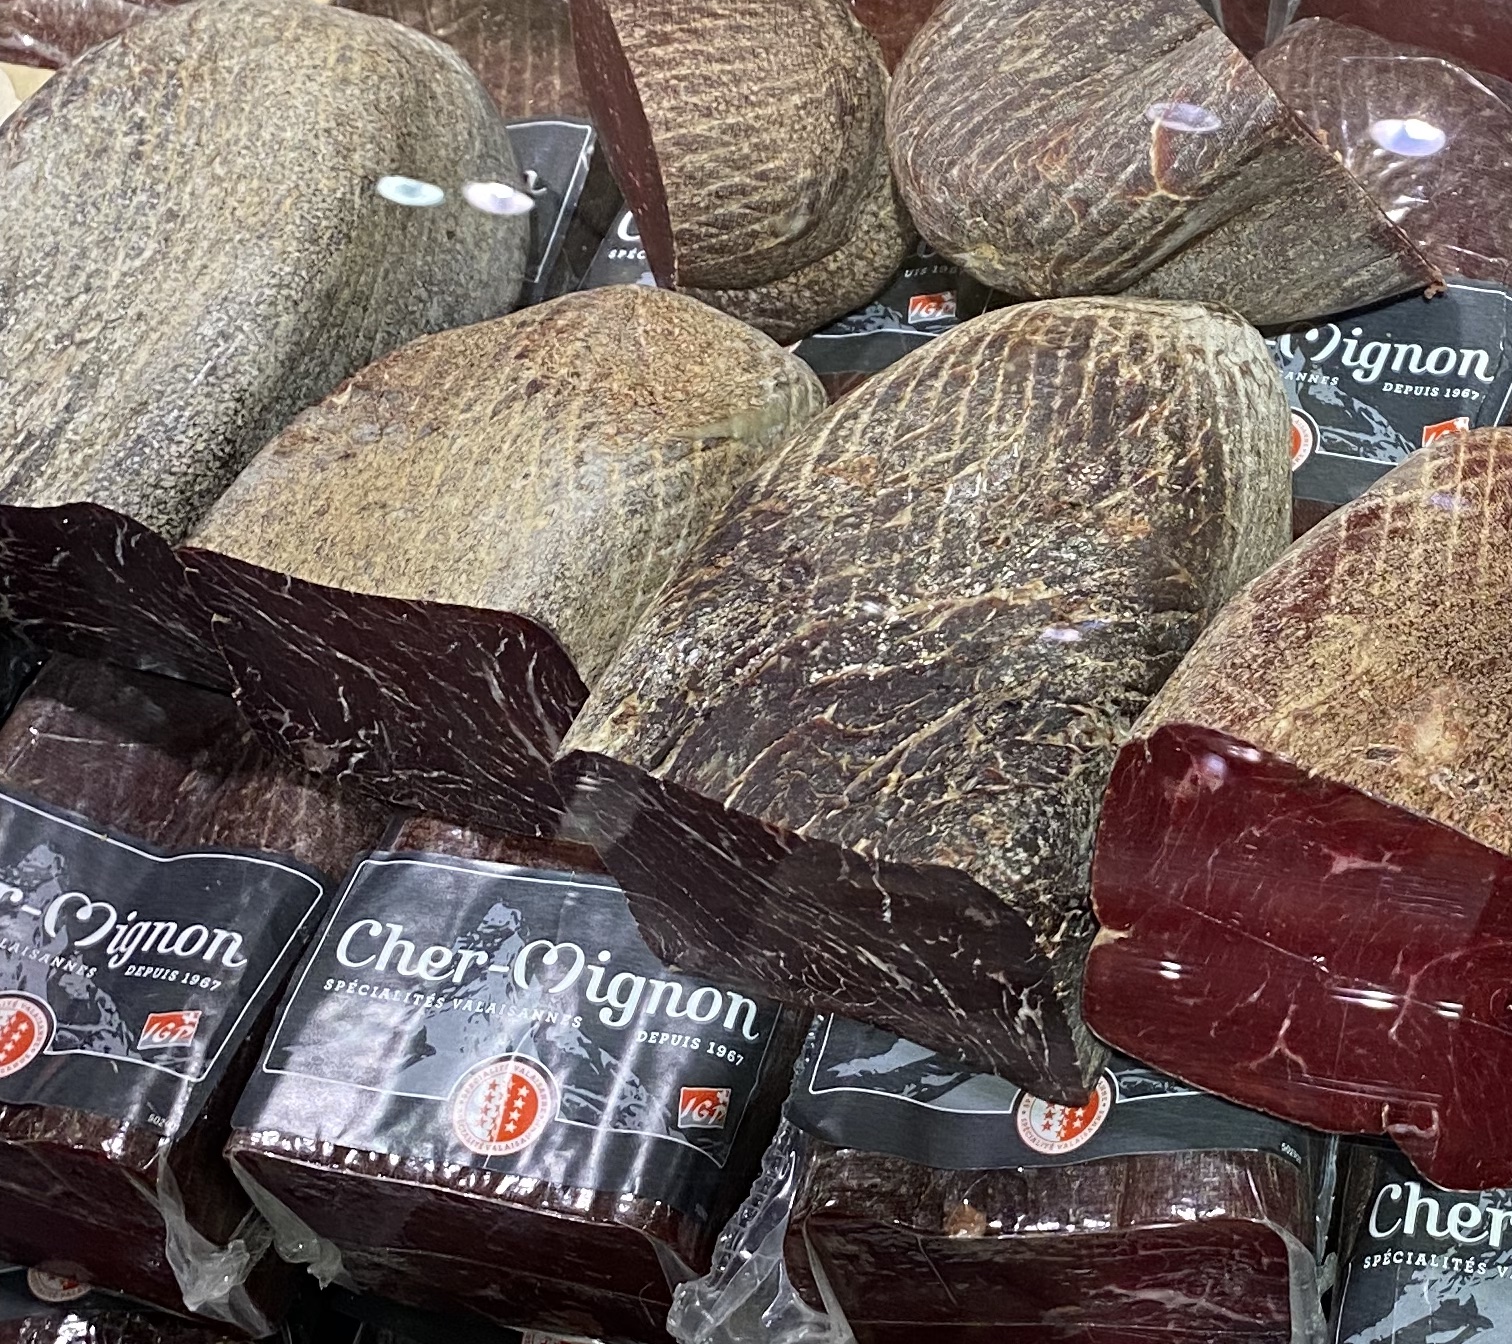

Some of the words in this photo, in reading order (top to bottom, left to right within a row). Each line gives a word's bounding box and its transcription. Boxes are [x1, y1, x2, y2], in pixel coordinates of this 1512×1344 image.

[1382, 381, 1440, 398] DEPUIS
[1443, 387, 1481, 401] 1967
[0, 937, 98, 979] LAISANNES
[124, 964, 180, 983] DEPUIS
[183, 972, 222, 992] 1967
[335, 918, 760, 1042] Cher-Mignon
[323, 977, 447, 1010] SPÉCIALITÉS
[452, 997, 584, 1030] VALAISANNES
[144, 1021, 195, 1044] IGP
[636, 1030, 702, 1052] DEPUIS
[706, 1040, 746, 1067] 1967
[681, 1097, 730, 1126] IGP
[1362, 1250, 1488, 1276] SPÉCIALITÉS
